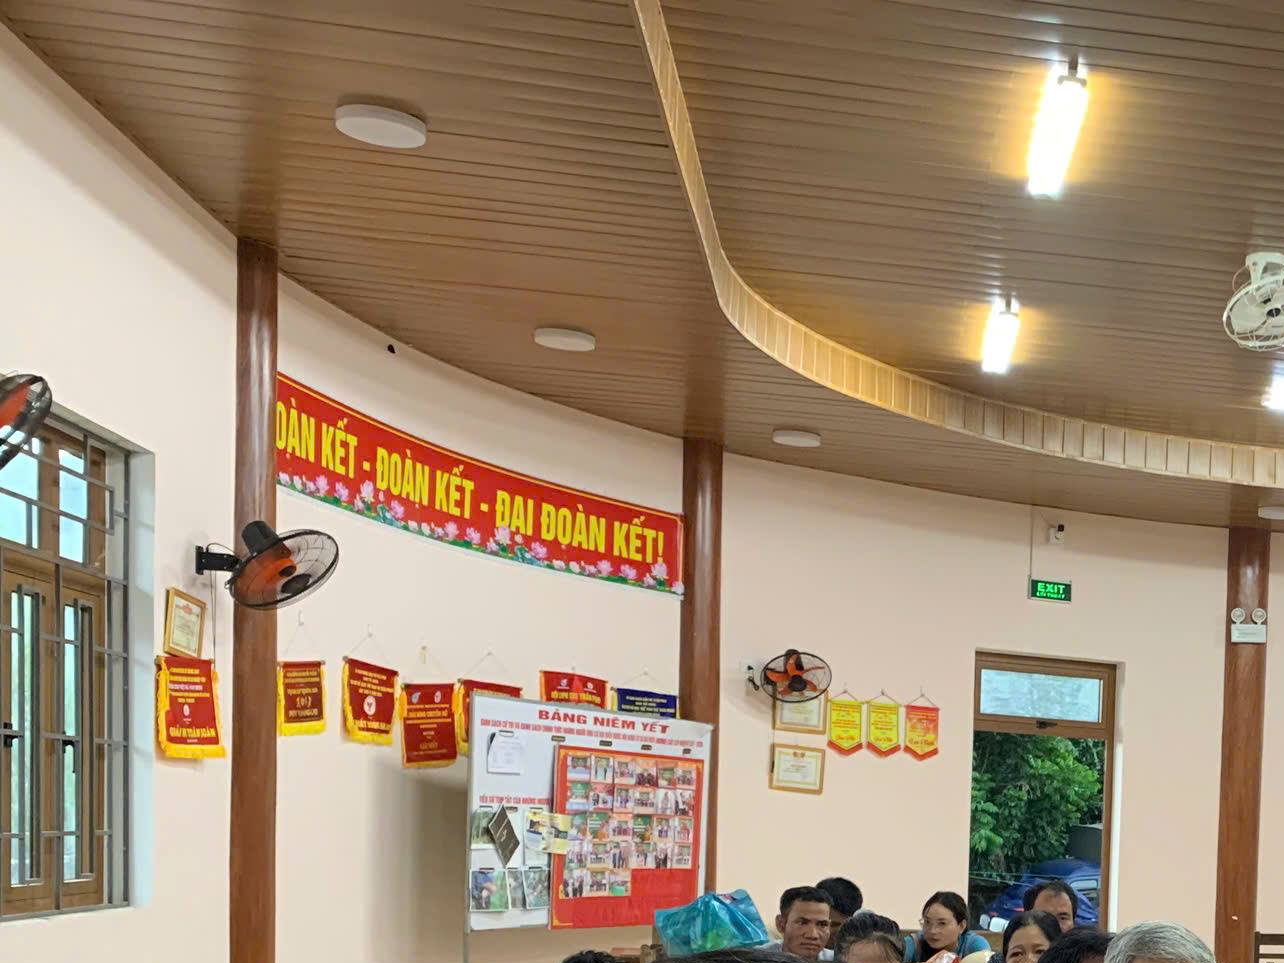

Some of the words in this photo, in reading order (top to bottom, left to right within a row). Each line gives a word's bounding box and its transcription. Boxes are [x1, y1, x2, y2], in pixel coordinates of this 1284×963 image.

[321, 418, 358, 479] KẾT
[376, 446, 430, 506] ĐOÀN
[435, 465, 474, 519] KẾT
[540, 502, 606, 553] ĐOÀN
[1037, 582, 1065, 594] EXIT
